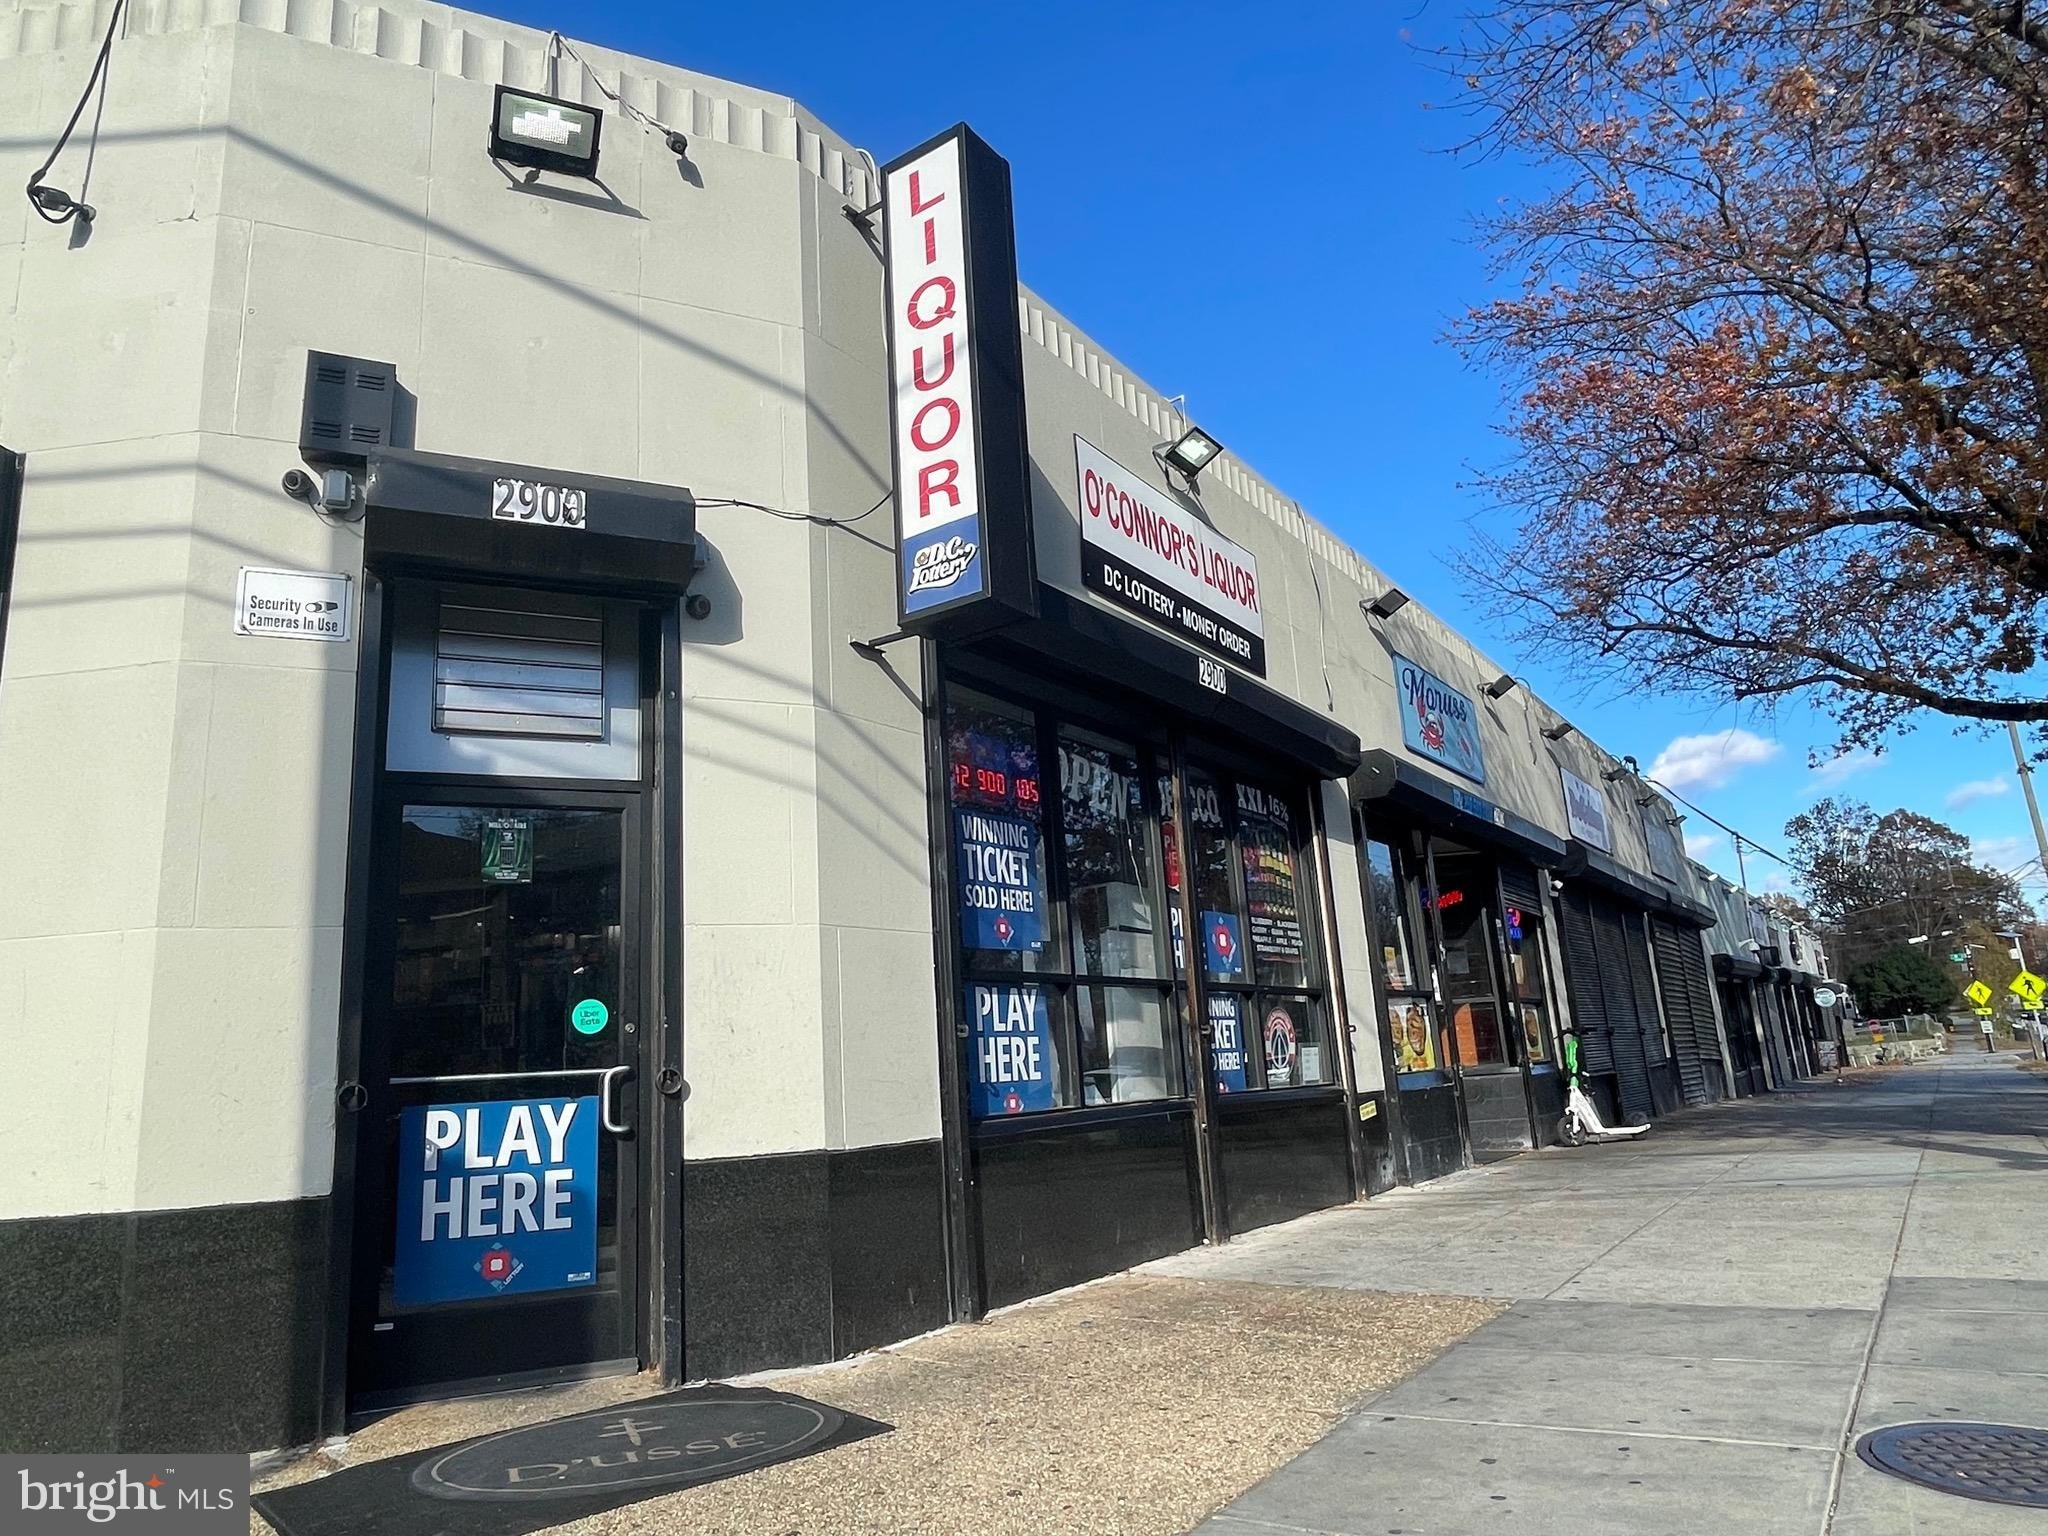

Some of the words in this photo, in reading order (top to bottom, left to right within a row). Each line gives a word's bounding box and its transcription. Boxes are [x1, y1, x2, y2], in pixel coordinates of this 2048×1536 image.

[907, 170, 961, 519] LIQUOR
[1084, 468, 1199, 578] O'CONNOR'S
[1200, 542, 1259, 614] LIQUOR
[909, 543, 977, 594] Lottery
[248, 612, 299, 629] Cameras
[303, 616, 314, 630] In
[317, 617, 338, 633] Use
[250, 594, 301, 615] Security
[1103, 564, 1123, 592] DC
[1124, 575, 1175, 619] LOTTERY
[1182, 606, 1218, 640] MONEY
[1219, 629, 1251, 660] ORDER
[977, 769, 1005, 795] 900
[1236, 783, 1267, 815] XXL
[961, 814, 1029, 849] WINNING
[962, 842, 1030, 887] TICKET
[965, 883, 998, 910] SOLD
[1000, 887, 1034, 913] HERE!
[975, 986, 1037, 1032] PLAY
[977, 1036, 1042, 1083] HERE
[423, 1102, 578, 1172] PLAY
[420, 1168, 574, 1242] HERE
